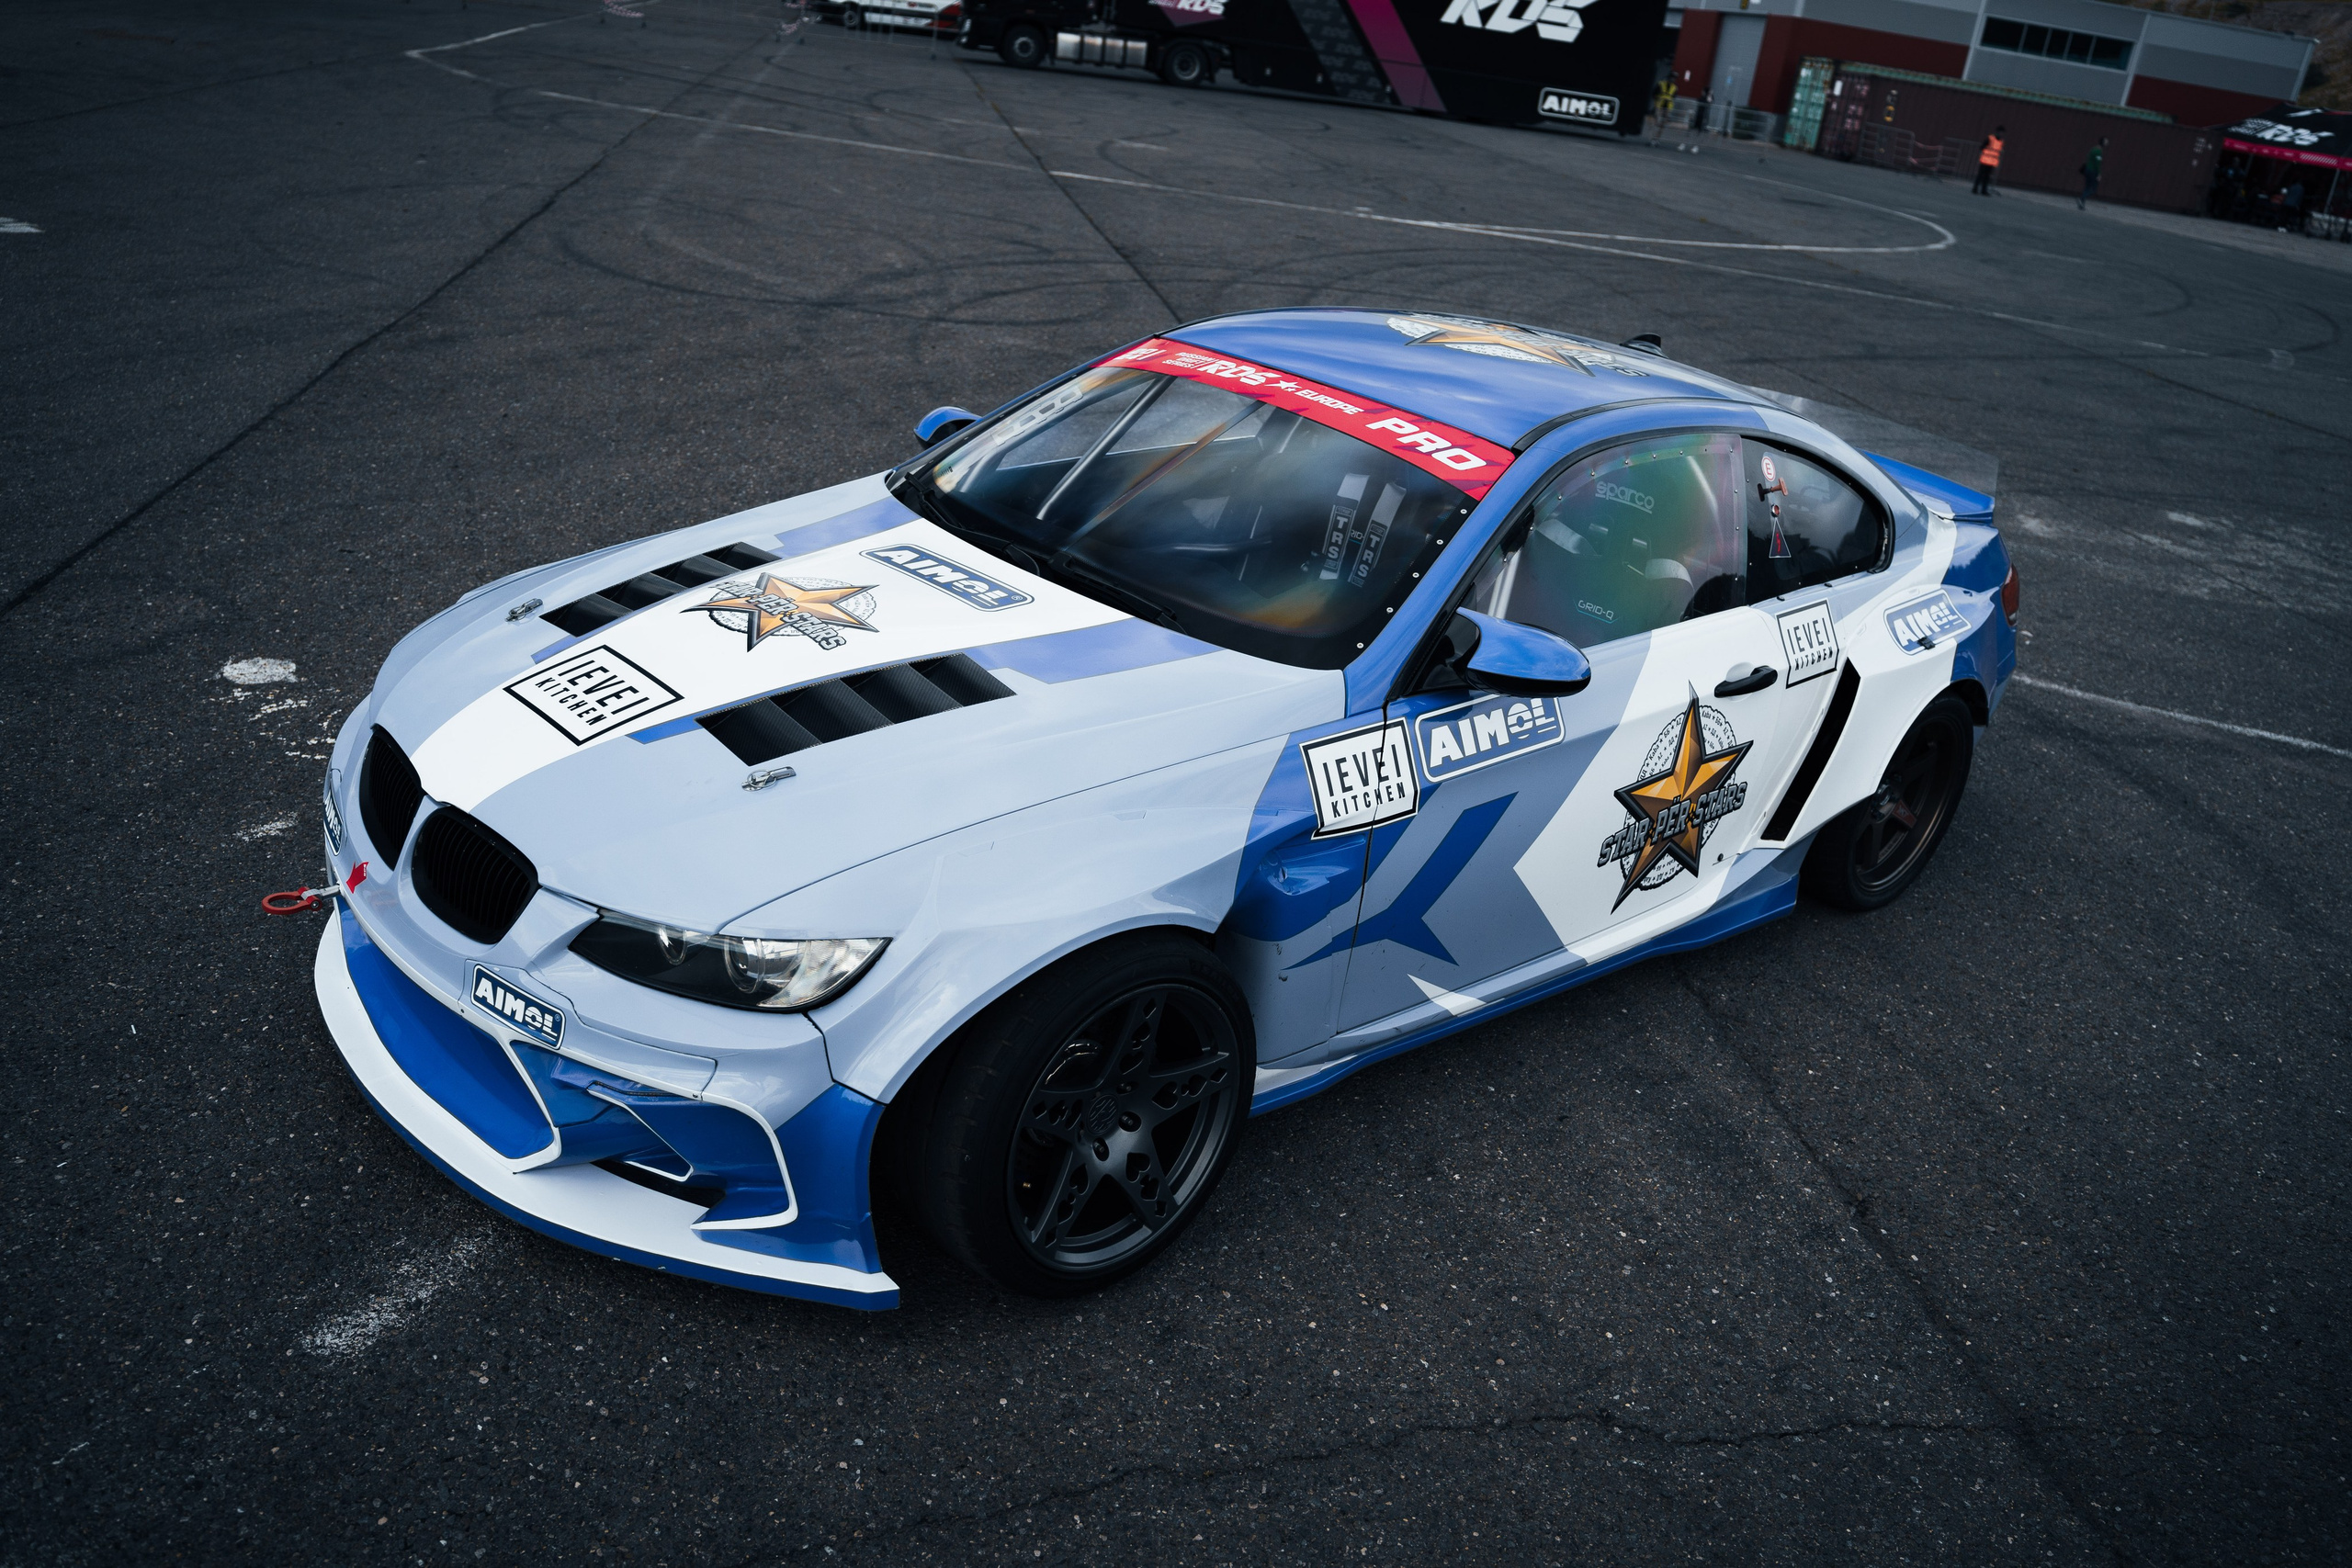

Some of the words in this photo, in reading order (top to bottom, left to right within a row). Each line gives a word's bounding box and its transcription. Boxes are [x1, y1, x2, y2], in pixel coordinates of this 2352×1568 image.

[1543, 95, 1613, 118] AIMOL
[1196, 360, 1283, 386] RDS
[1294, 389, 1364, 415] EUROPE
[1364, 417, 1487, 470] PRO
[1765, 462, 1772, 476] E
[1596, 480, 1655, 510] sparco
[873, 549, 1009, 607] AIMOL
[783, 611, 847, 650] STARS
[1577, 600, 1614, 621] GRID-Q
[1893, 602, 1963, 647] AIMOL
[1794, 646, 1834, 671] KITCHEN
[535, 677, 607, 727] KITCHEN
[1430, 698, 1557, 768] AIMOL
[1330, 782, 1406, 818] KITCHEN
[1597, 817, 1652, 867] STAR
[1691, 781, 1747, 829] STARS
[475, 976, 558, 1041] AIMOL
